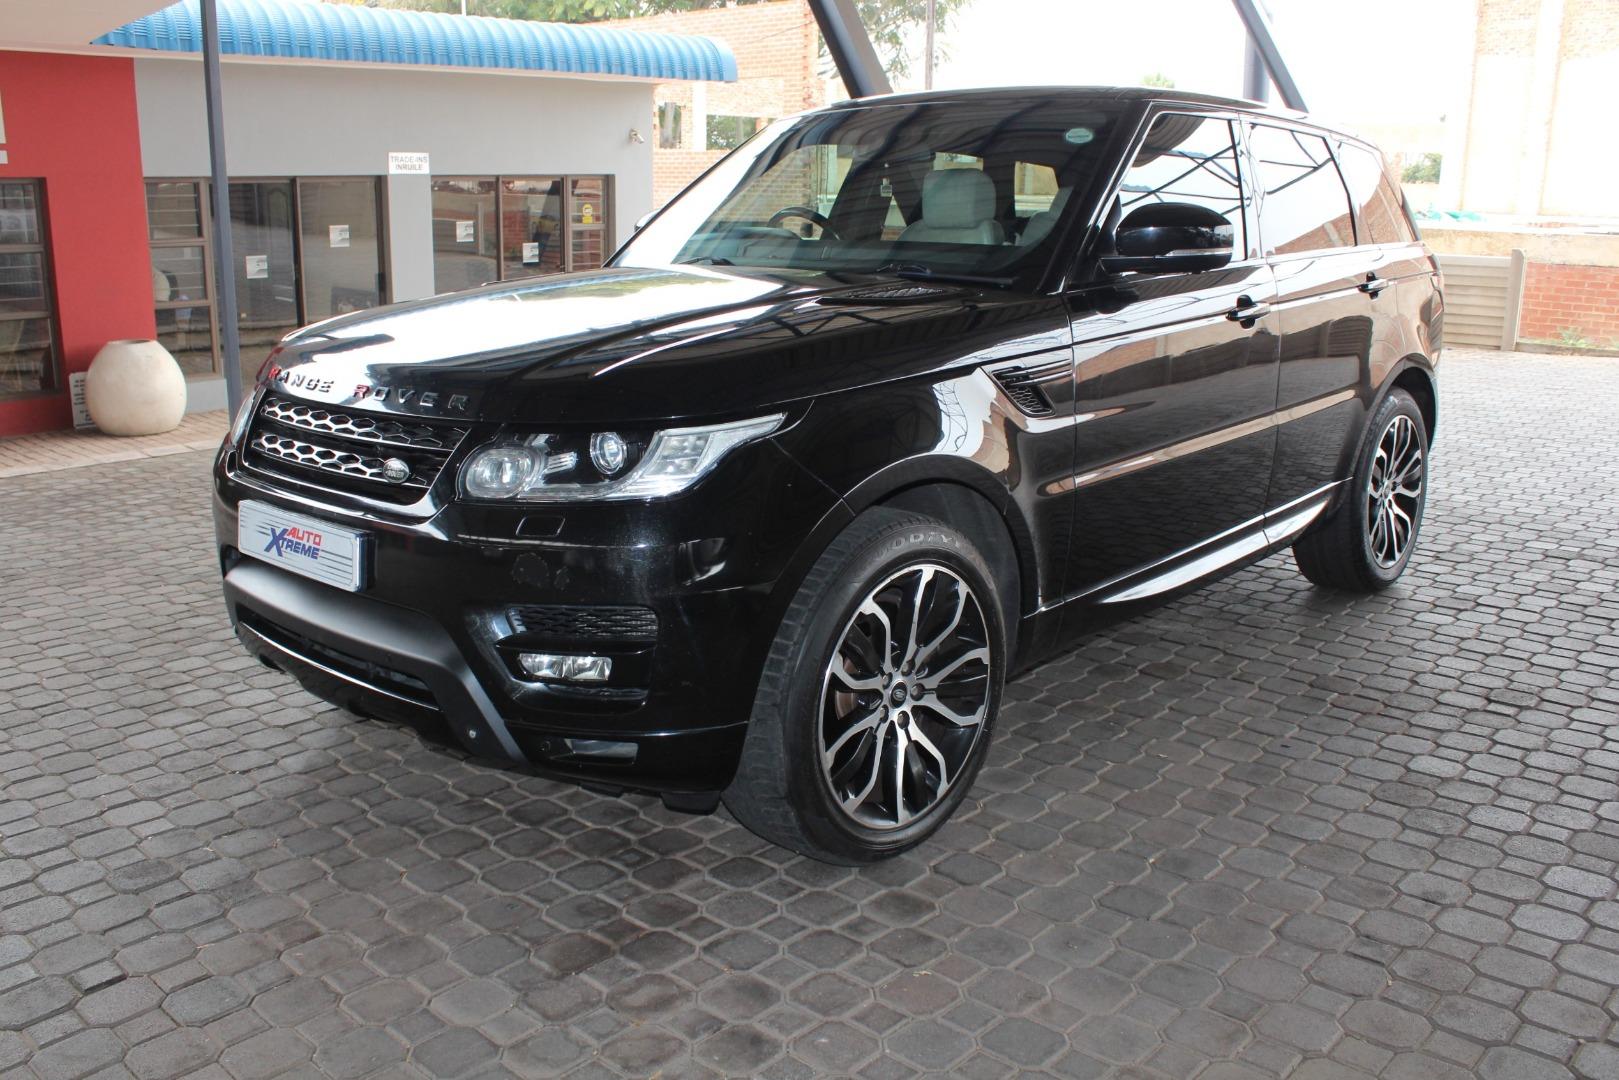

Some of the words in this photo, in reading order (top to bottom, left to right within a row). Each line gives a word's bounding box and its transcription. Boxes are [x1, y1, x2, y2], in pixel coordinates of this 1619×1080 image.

[268, 366, 335, 394] RANGE
[354, 384, 469, 411] ROVER
[264, 527, 320, 560] XTREME
[286, 527, 322, 547] AUTO
